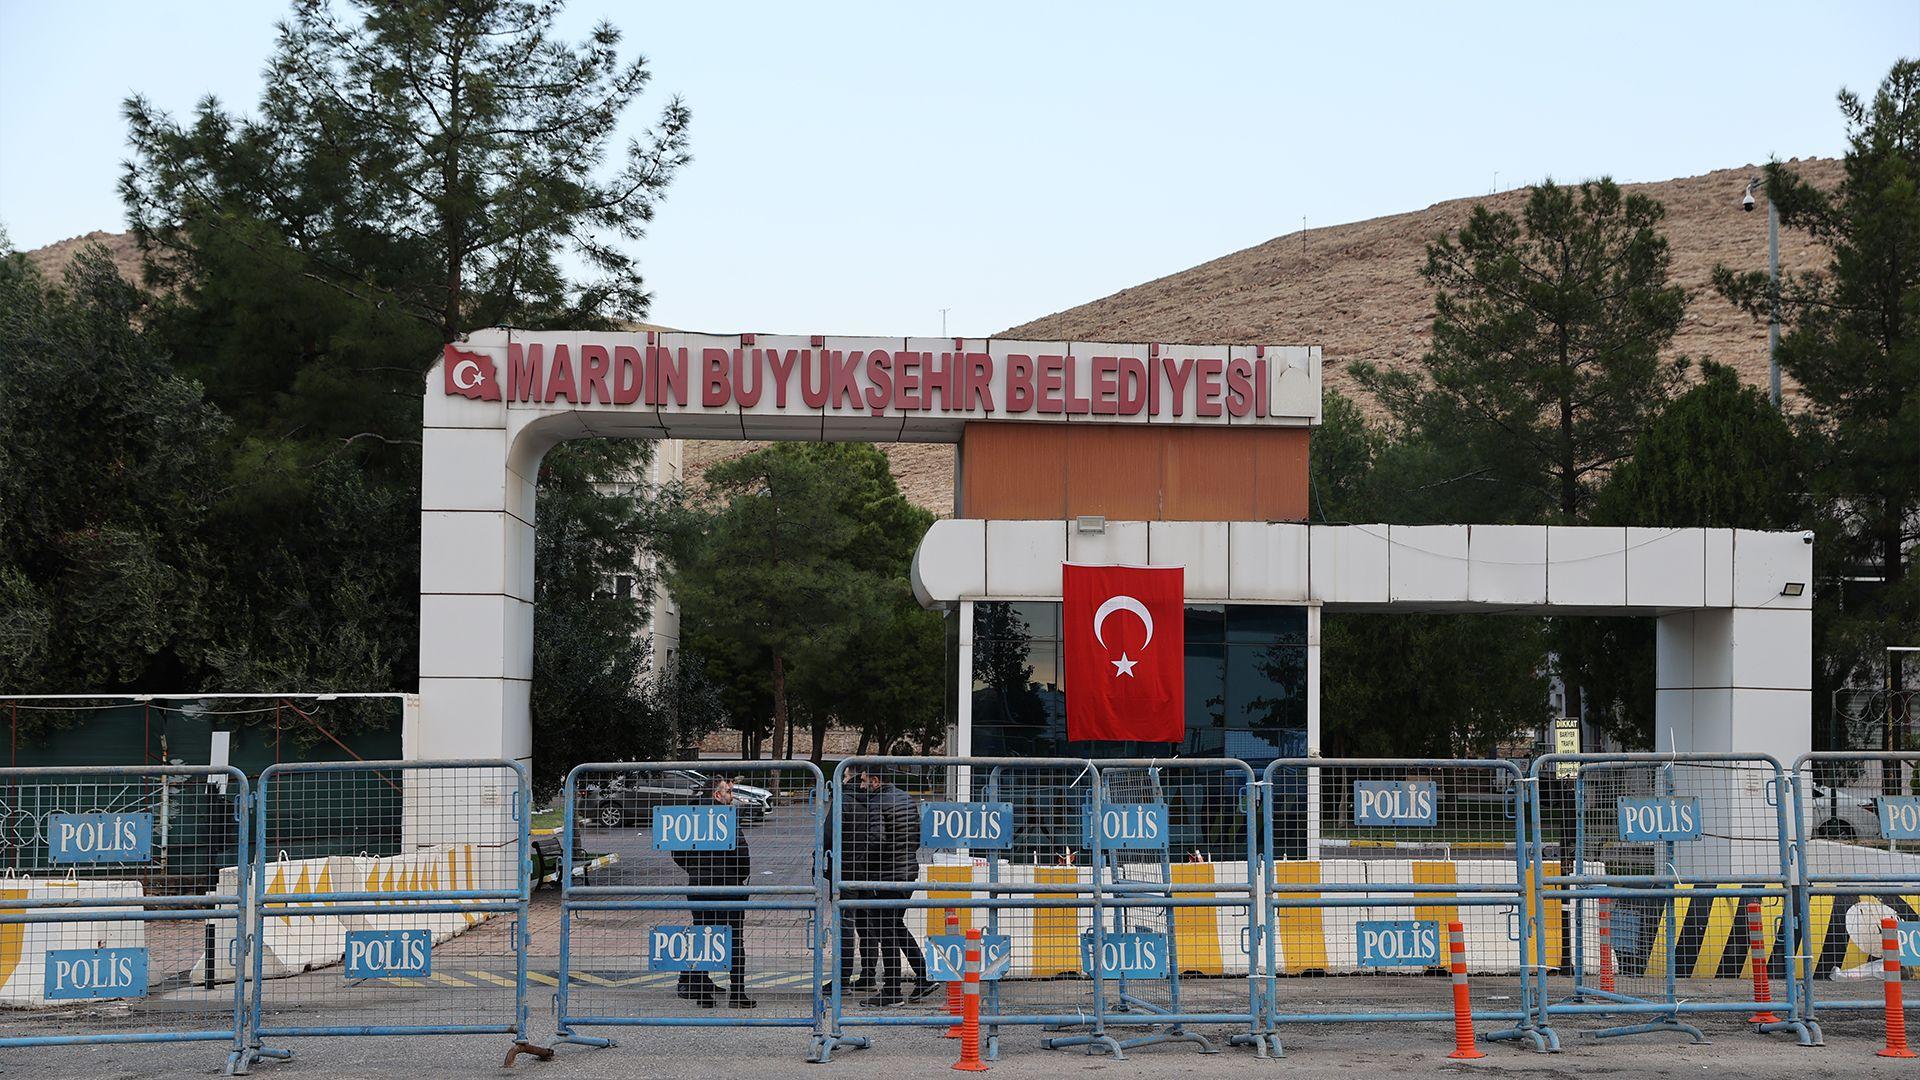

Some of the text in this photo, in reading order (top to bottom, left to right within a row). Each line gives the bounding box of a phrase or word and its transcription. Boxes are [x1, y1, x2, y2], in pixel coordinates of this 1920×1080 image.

[507, 331, 1267, 418] MARDİN BÜYÜKŞEHİR BELEDİYESİ
[1556, 719, 1578, 728] DİKKAT
[1359, 784, 1431, 819] POLİS
[1623, 800, 1694, 834] POLİS
[1886, 803, 1920, 832] PO
[60, 816, 137, 853] POLİS
[660, 807, 728, 842] POLİS
[931, 804, 1001, 840] POLİS
[349, 931, 425, 971] POLİS
[653, 926, 727, 963] POLİS
[931, 938, 1001, 973] POİS
[1363, 920, 1436, 960] POLİS
[55, 952, 133, 991] POLİS
